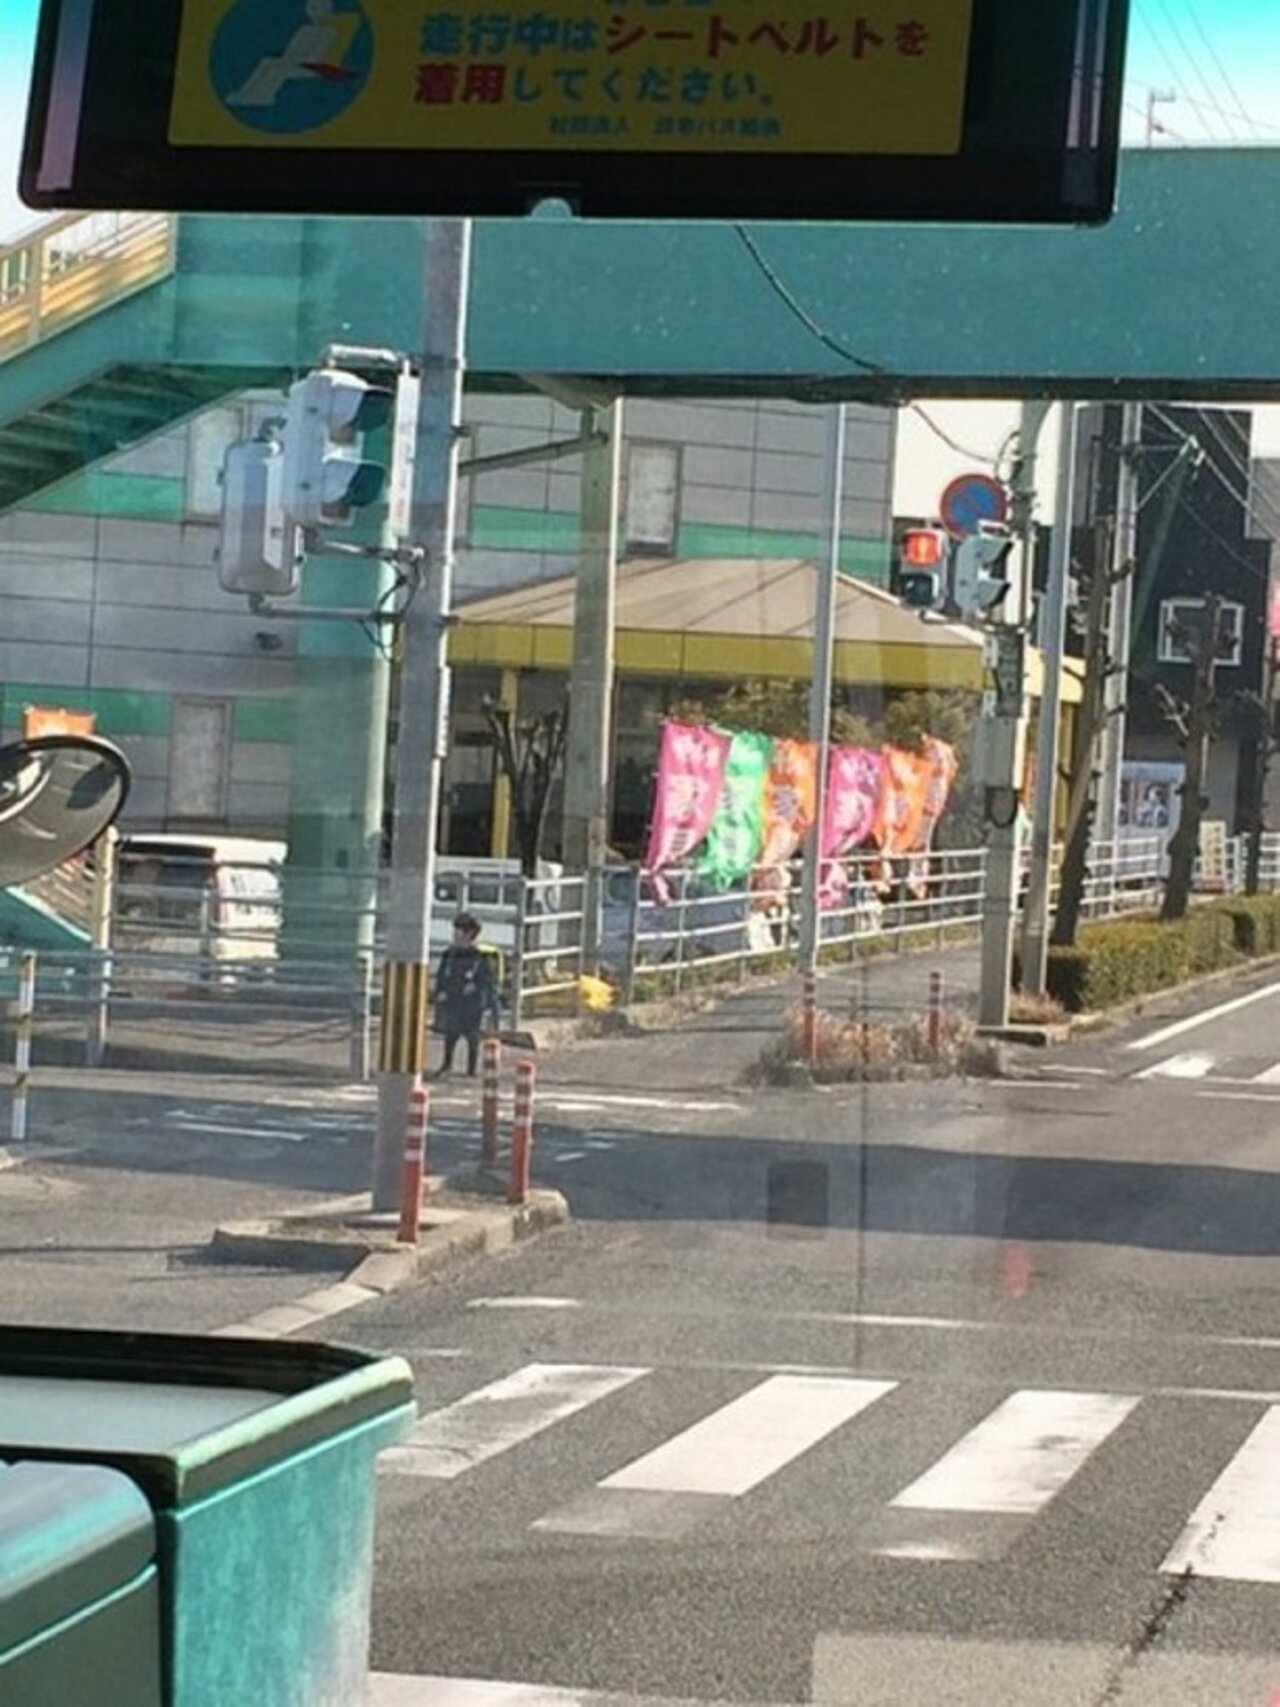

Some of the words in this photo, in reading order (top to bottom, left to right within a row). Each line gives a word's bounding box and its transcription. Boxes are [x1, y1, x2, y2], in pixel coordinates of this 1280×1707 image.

[420, 13, 927, 57] 走行中はシートベルトを
